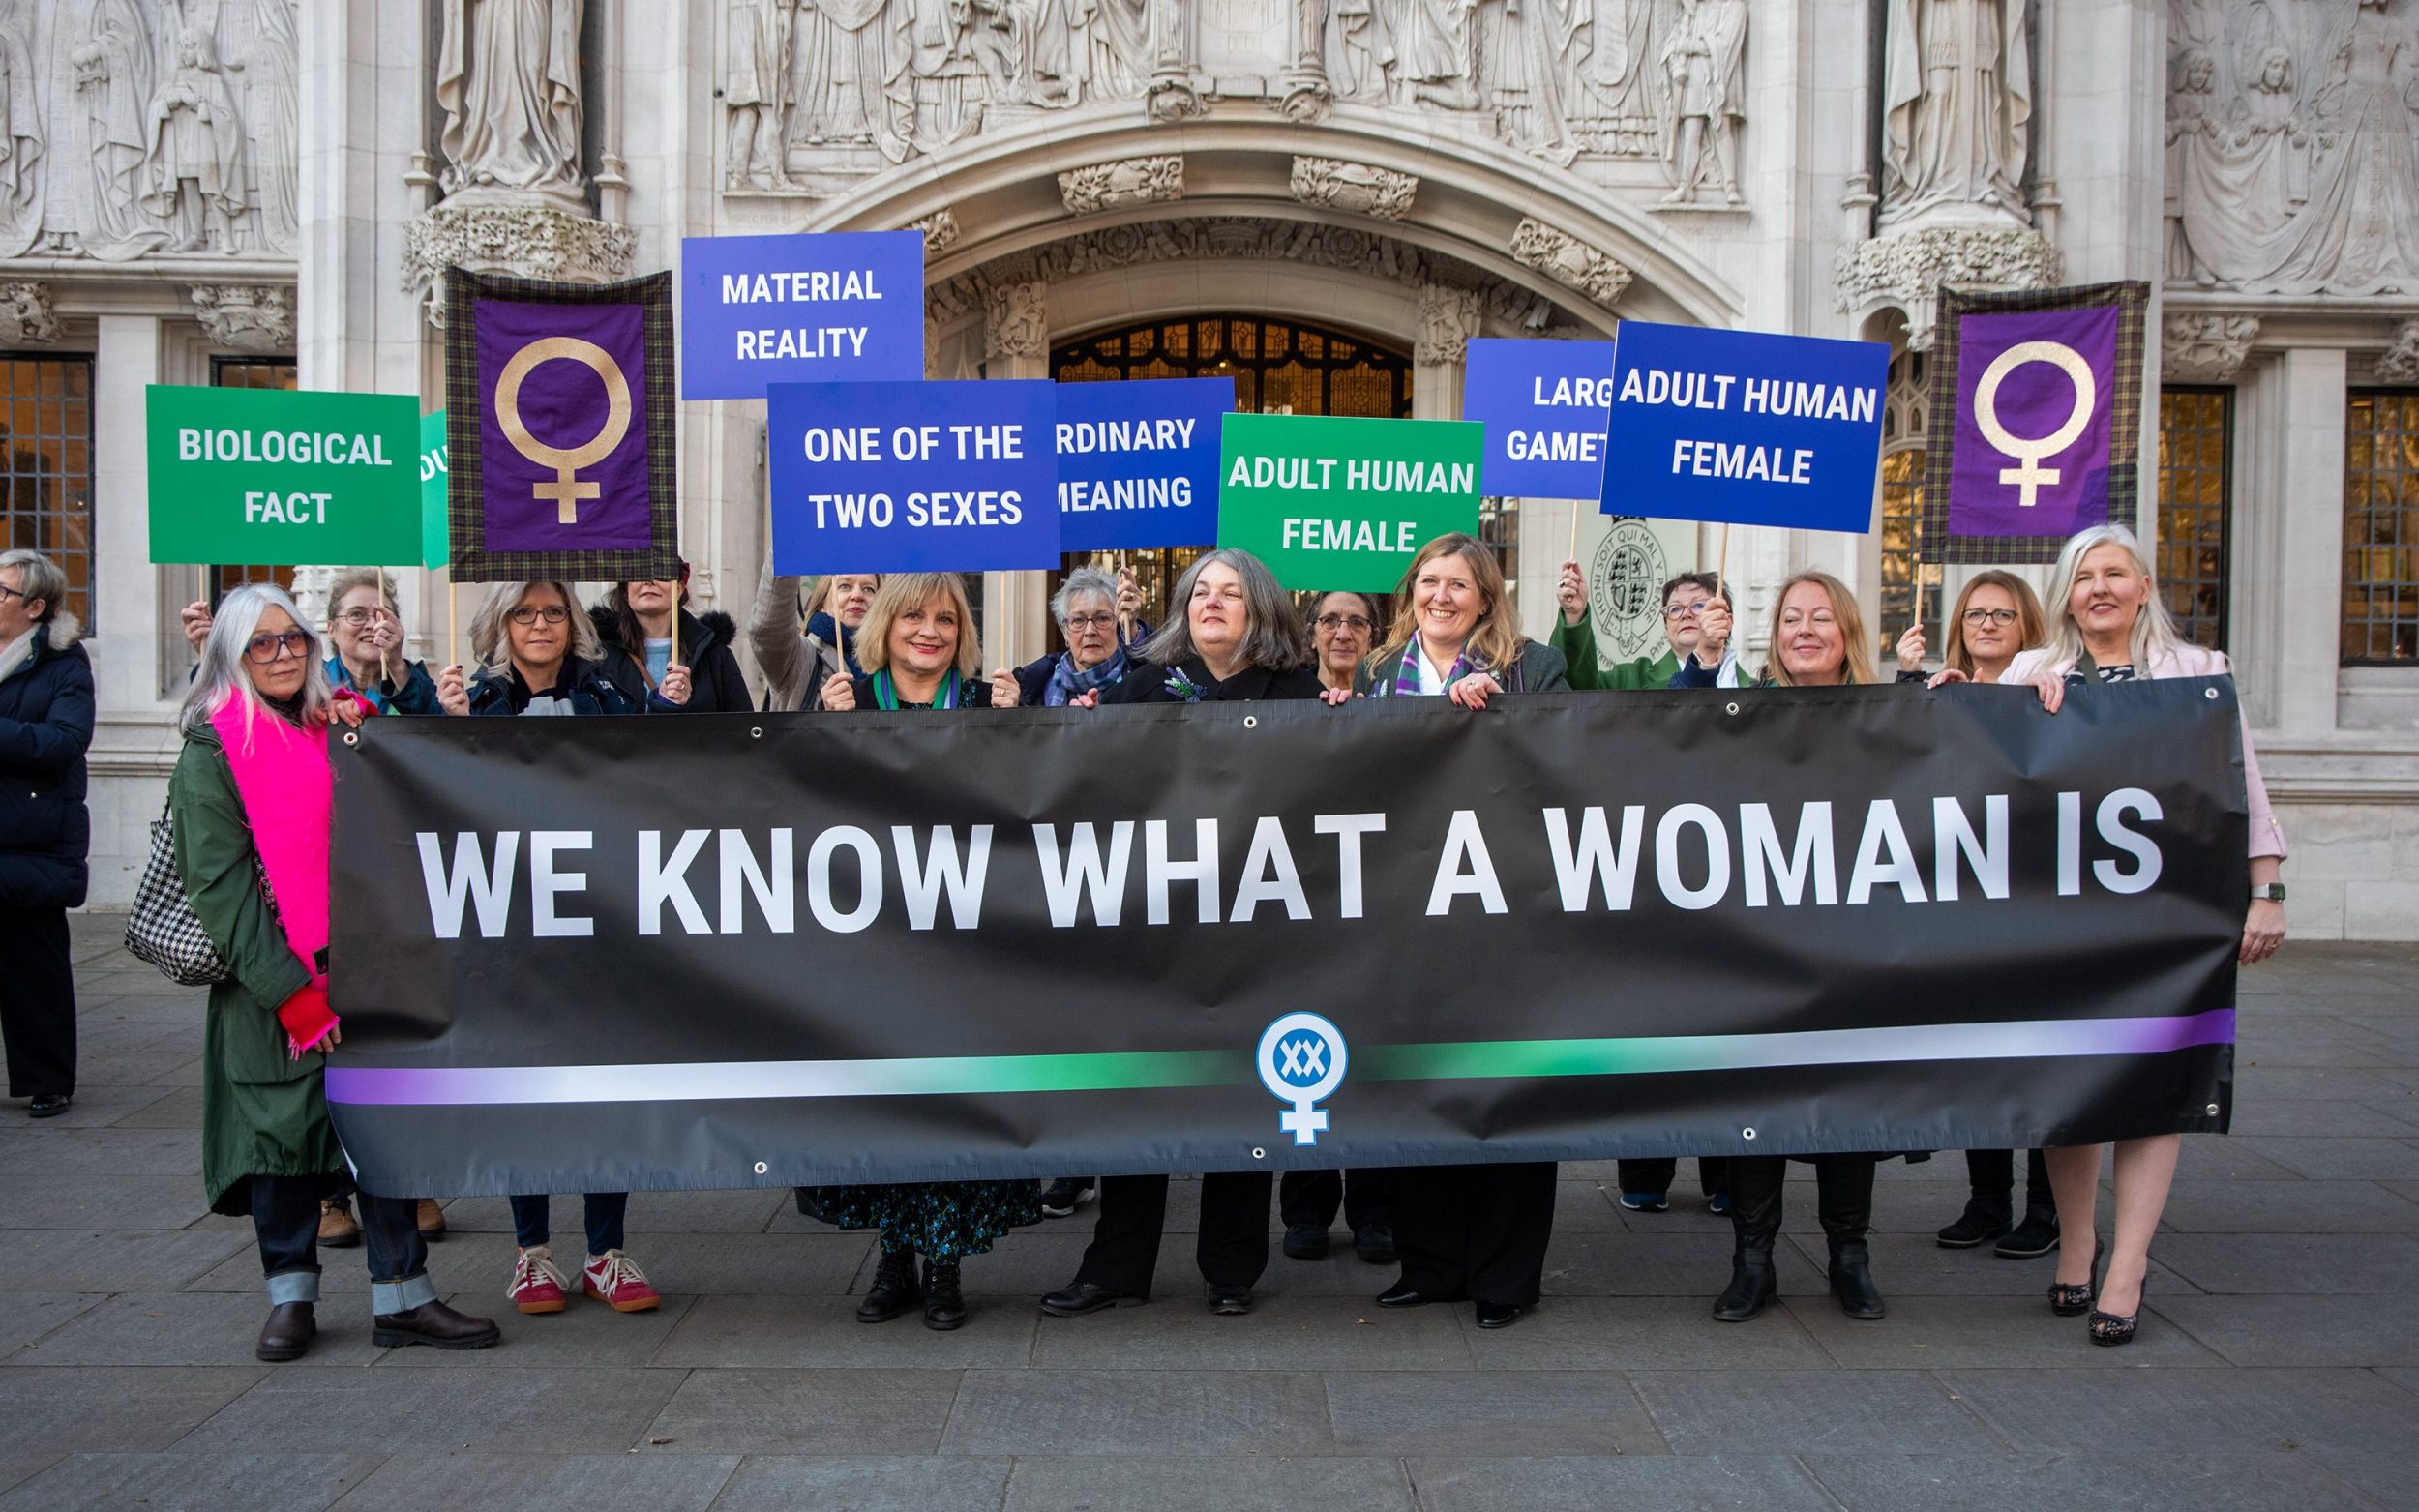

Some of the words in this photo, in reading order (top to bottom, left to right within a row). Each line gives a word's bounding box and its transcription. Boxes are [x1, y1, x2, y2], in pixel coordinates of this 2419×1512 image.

[722, 270, 882, 304] MATERIAL
[737, 327, 868, 360] REALITY
[1534, 376, 1612, 407] LARG
[1618, 368, 1736, 410] ADULT
[1743, 377, 1877, 423] HUMAN
[179, 428, 393, 465] BIOLOGICAL
[804, 427, 881, 462] ONE
[892, 426, 940, 461] OF
[948, 425, 1024, 460] THE
[1056, 418, 1196, 454] RDINARY
[1228, 456, 1338, 489] ADULT
[1347, 460, 1474, 494] HUMAN
[1672, 439, 1814, 489] FEMALE
[245, 491, 332, 524] FACT
[808, 492, 894, 529] TWO
[906, 490, 1023, 527] SEXES
[1282, 518, 1417, 552] FEMALE
[1617, 528, 1638, 543] QUI
[1639, 532, 1658, 559] MAL
[1597, 536, 1615, 571] SOIT
[1655, 560, 1664, 571] Y
[1594, 574, 1606, 616] HONI
[1644, 577, 1665, 624] PENSE
[415, 830, 594, 938] WE
[638, 824, 994, 935] KNOW
[1031, 812, 1387, 928] WHAT
[1425, 810, 1509, 916] A
[1542, 794, 2010, 912] WOMAN
[2057, 787, 2164, 896] IS
